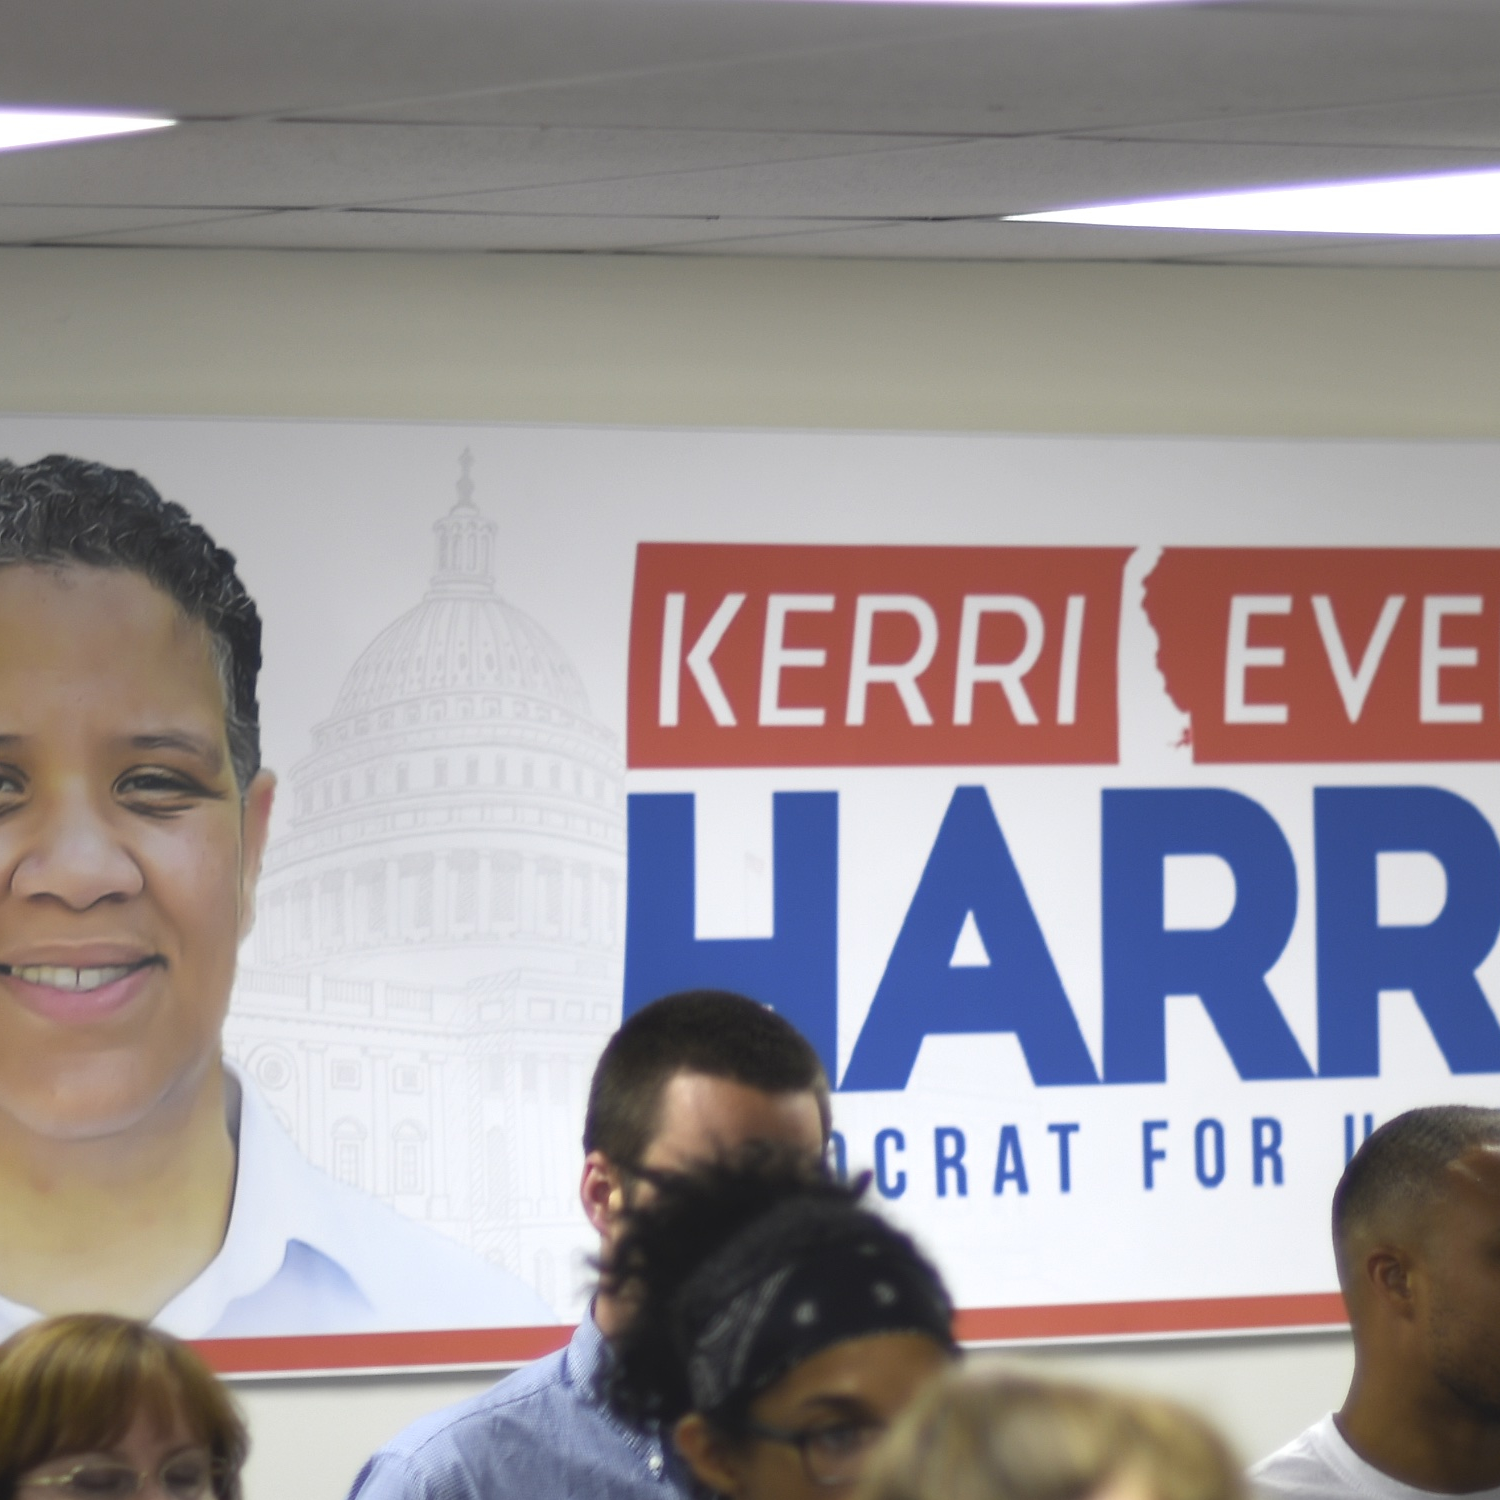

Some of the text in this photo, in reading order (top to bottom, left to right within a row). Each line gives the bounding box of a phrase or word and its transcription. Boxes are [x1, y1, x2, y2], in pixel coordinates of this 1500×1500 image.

[656, 592, 1087, 728] KERRI
[828, 1120, 1080, 1200] CRAT
[1141, 1116, 1286, 1192] FOR
